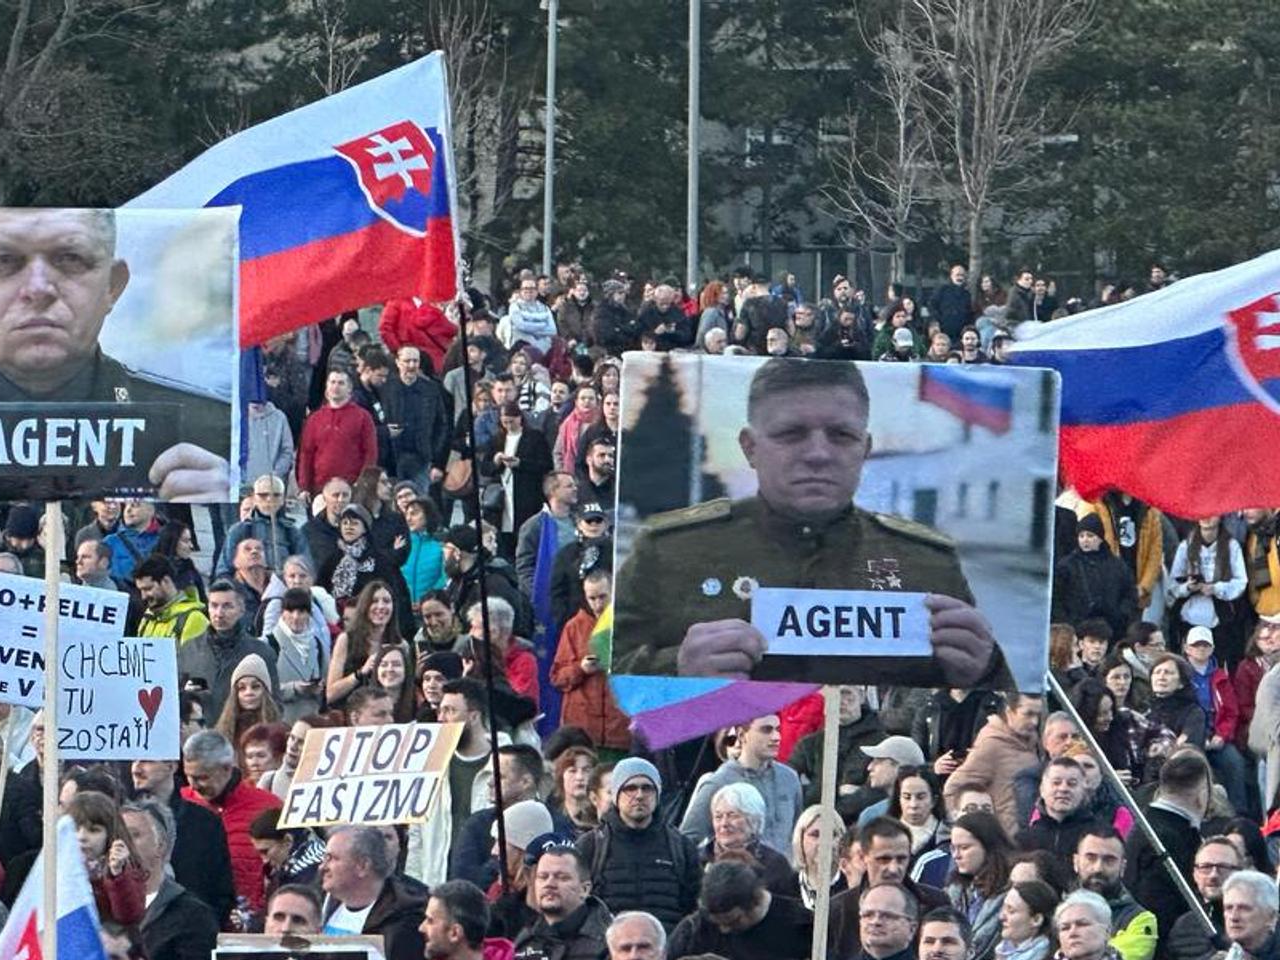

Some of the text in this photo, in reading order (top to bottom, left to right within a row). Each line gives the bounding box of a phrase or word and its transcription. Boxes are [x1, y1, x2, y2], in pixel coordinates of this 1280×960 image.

[776, 604, 907, 639] AGENT
[61, 641, 156, 684] CHCEME
[18, 678, 36, 697] V
[63, 687, 94, 716] TU
[317, 728, 433, 776] STOP
[284, 774, 440, 824] FAŠIZMU
